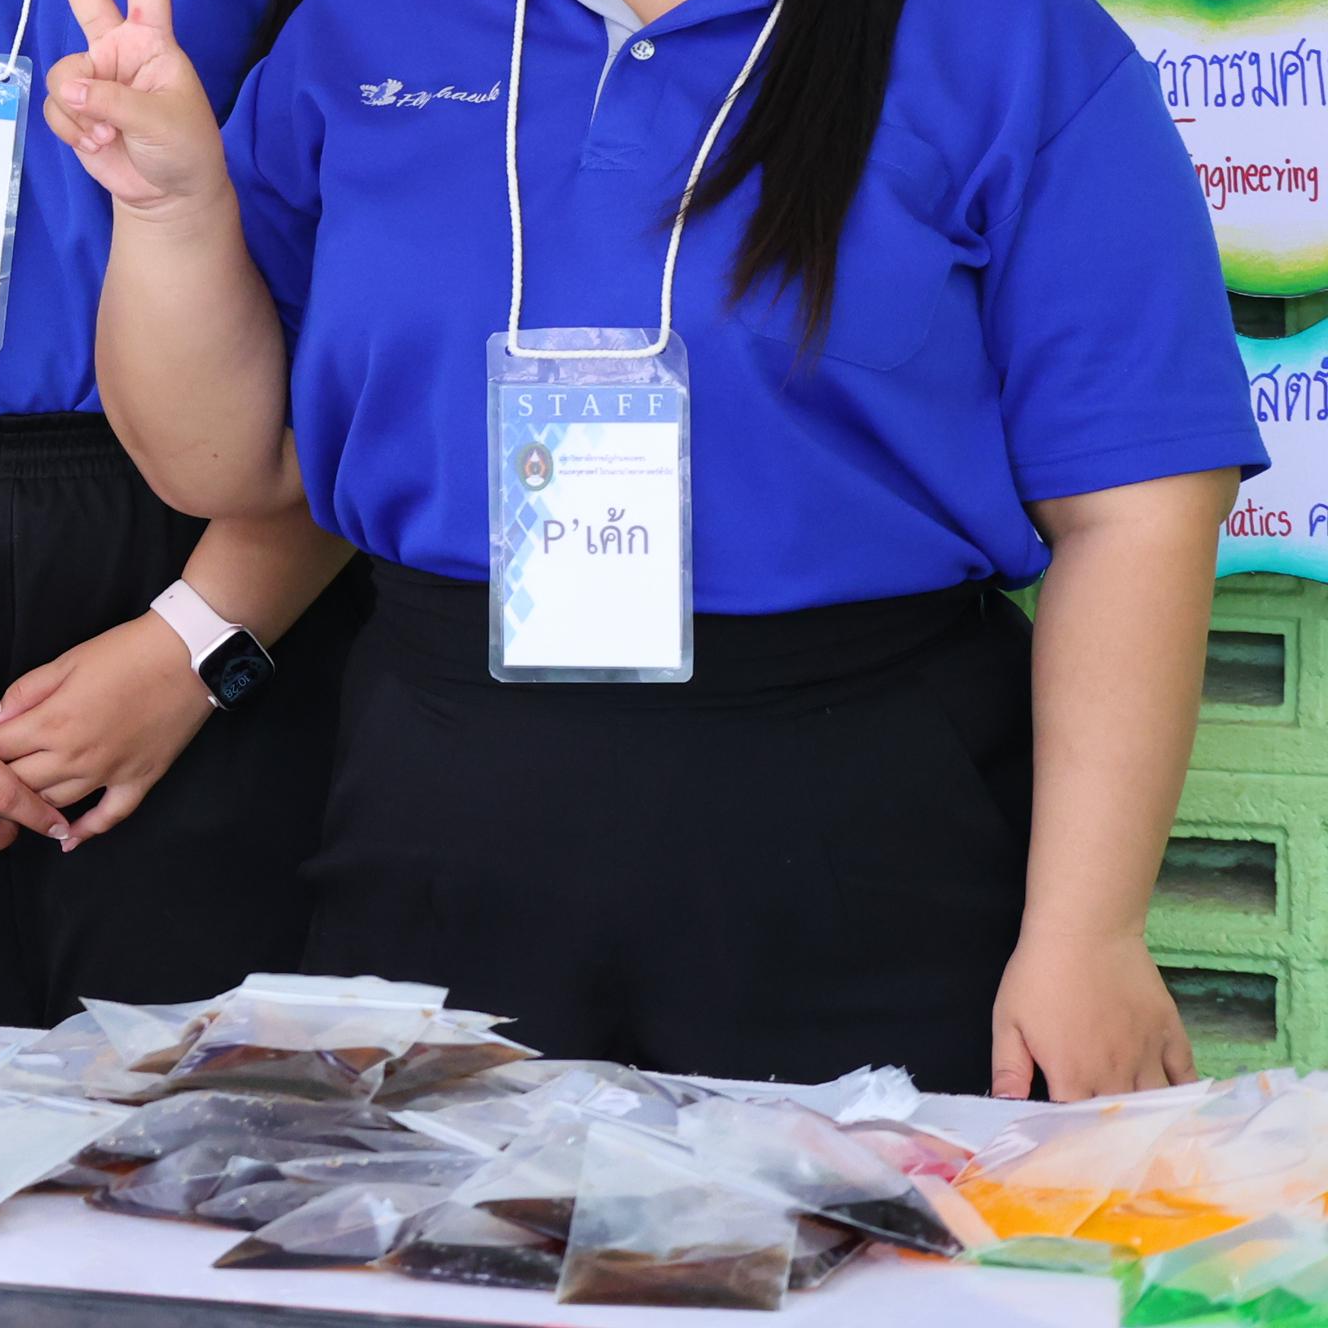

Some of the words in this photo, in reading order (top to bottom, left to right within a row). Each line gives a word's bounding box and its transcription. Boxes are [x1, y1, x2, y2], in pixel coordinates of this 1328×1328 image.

[1182, 134, 1319, 210] ngineering
[517, 393, 664, 417] STAFF
[543, 507, 649, 555] P'เค้ก
[1226, 498, 1293, 538] atics
